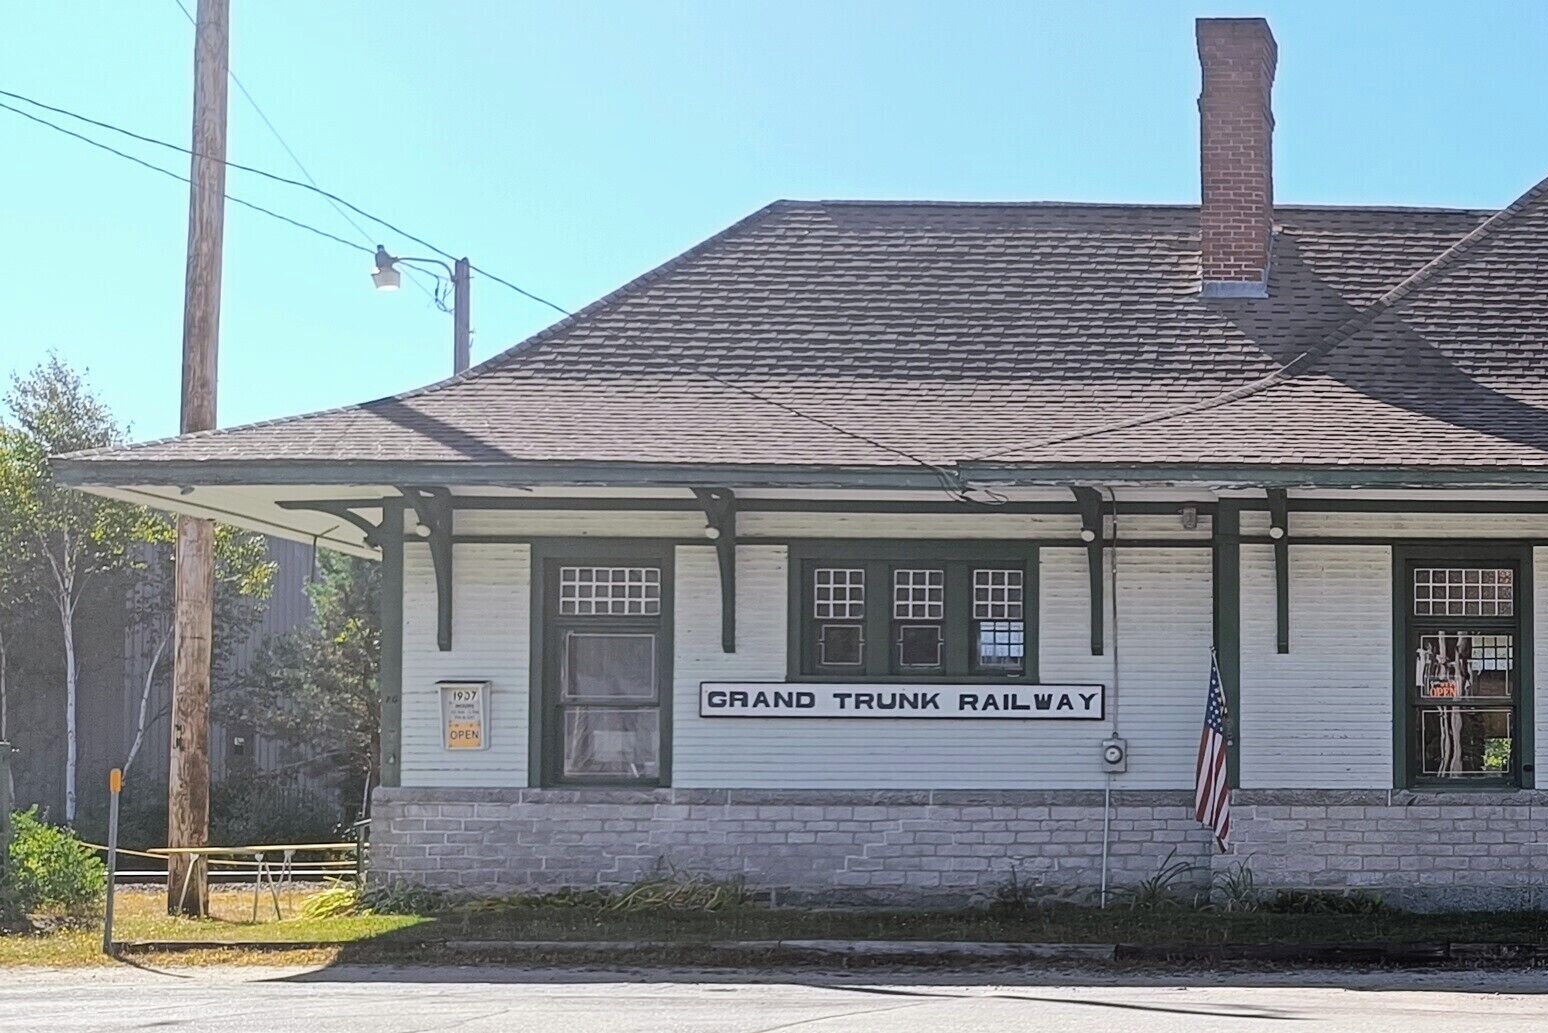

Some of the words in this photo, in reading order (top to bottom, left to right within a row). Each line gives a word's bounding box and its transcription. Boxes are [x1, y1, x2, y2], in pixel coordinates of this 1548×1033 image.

[1429, 687, 1457, 697] OPEN
[707, 690, 816, 709] GRAND
[833, 692, 940, 710] TRUNK
[958, 692, 1099, 711] RAILWAY
[450, 730, 479, 740] OPEN
